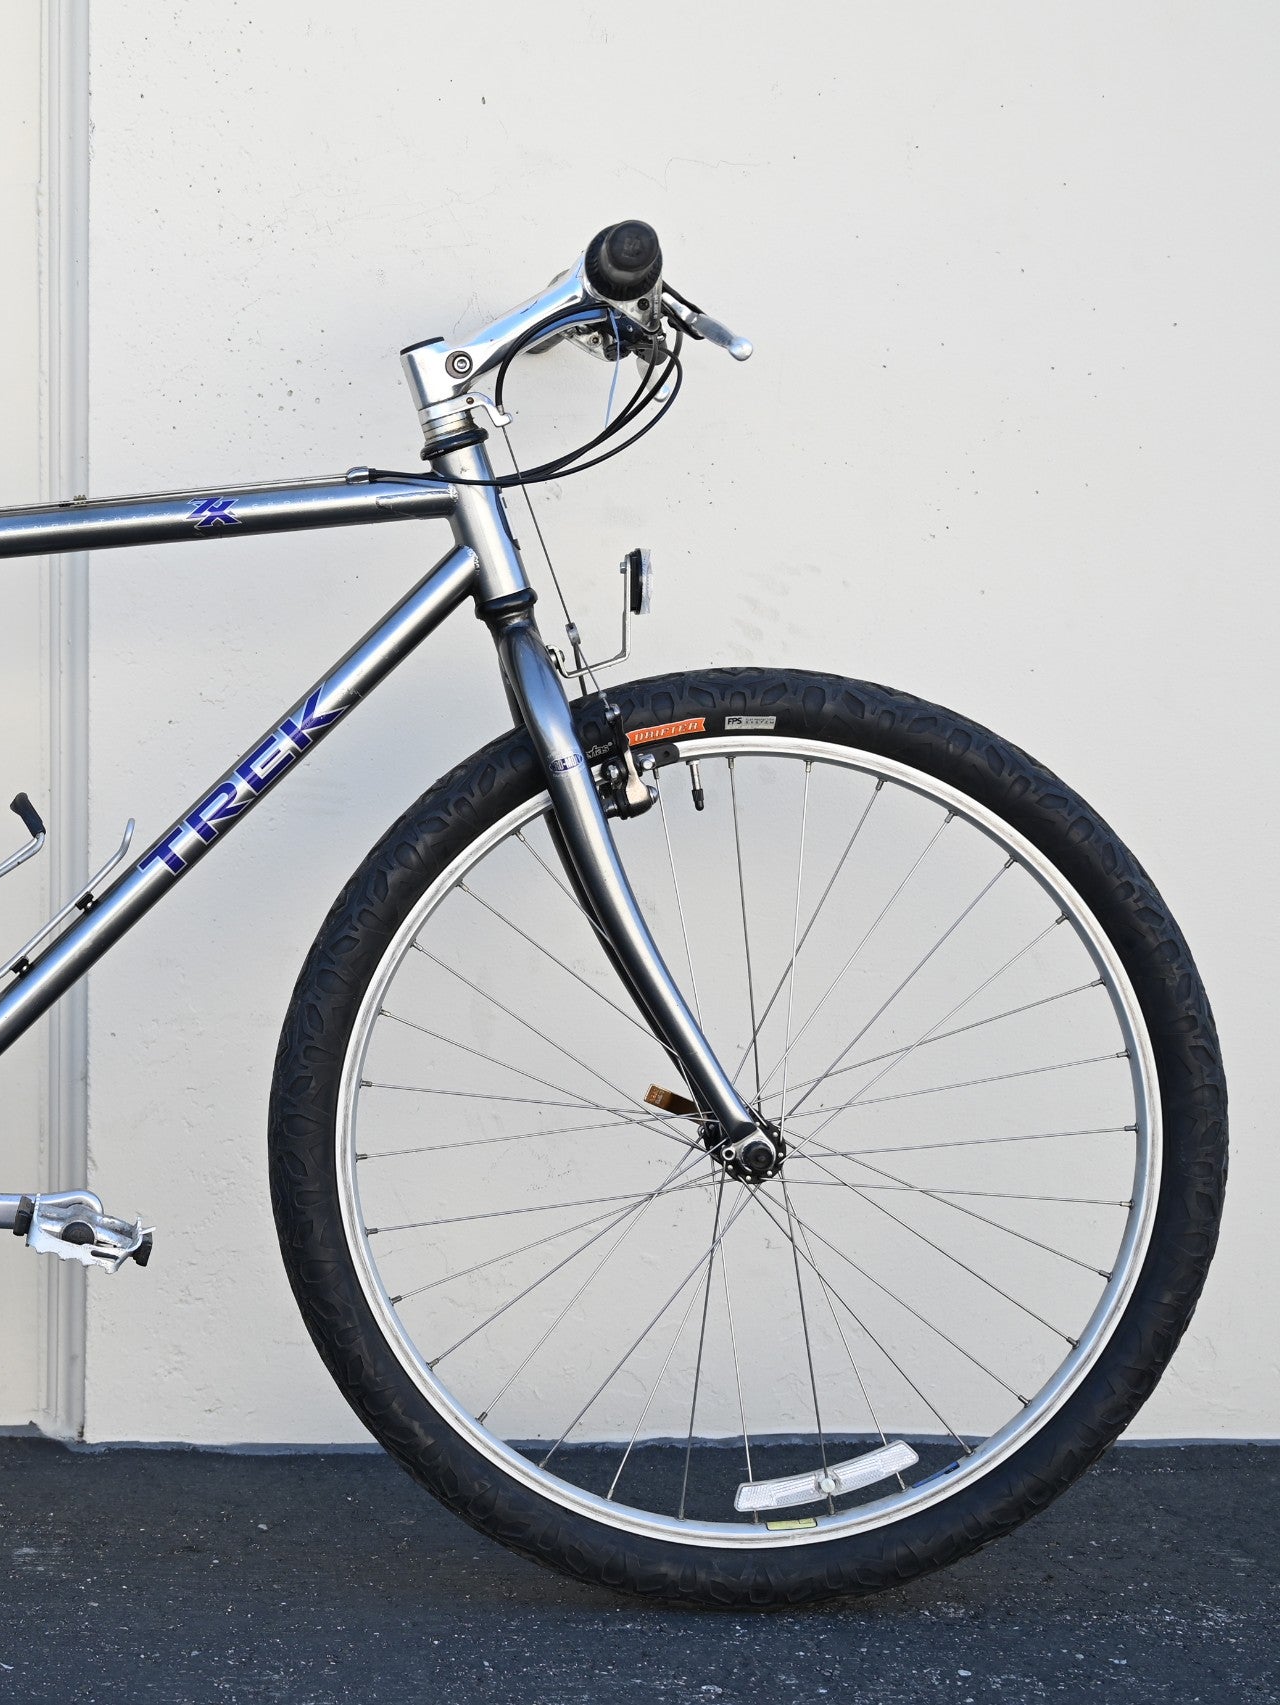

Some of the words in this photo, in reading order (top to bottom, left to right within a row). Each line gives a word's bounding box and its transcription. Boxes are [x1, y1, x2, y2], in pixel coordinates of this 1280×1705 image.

[727, 717, 743, 725] FPS
[634, 722, 699, 742] DRIFTER
[137, 682, 351, 876] TREK
